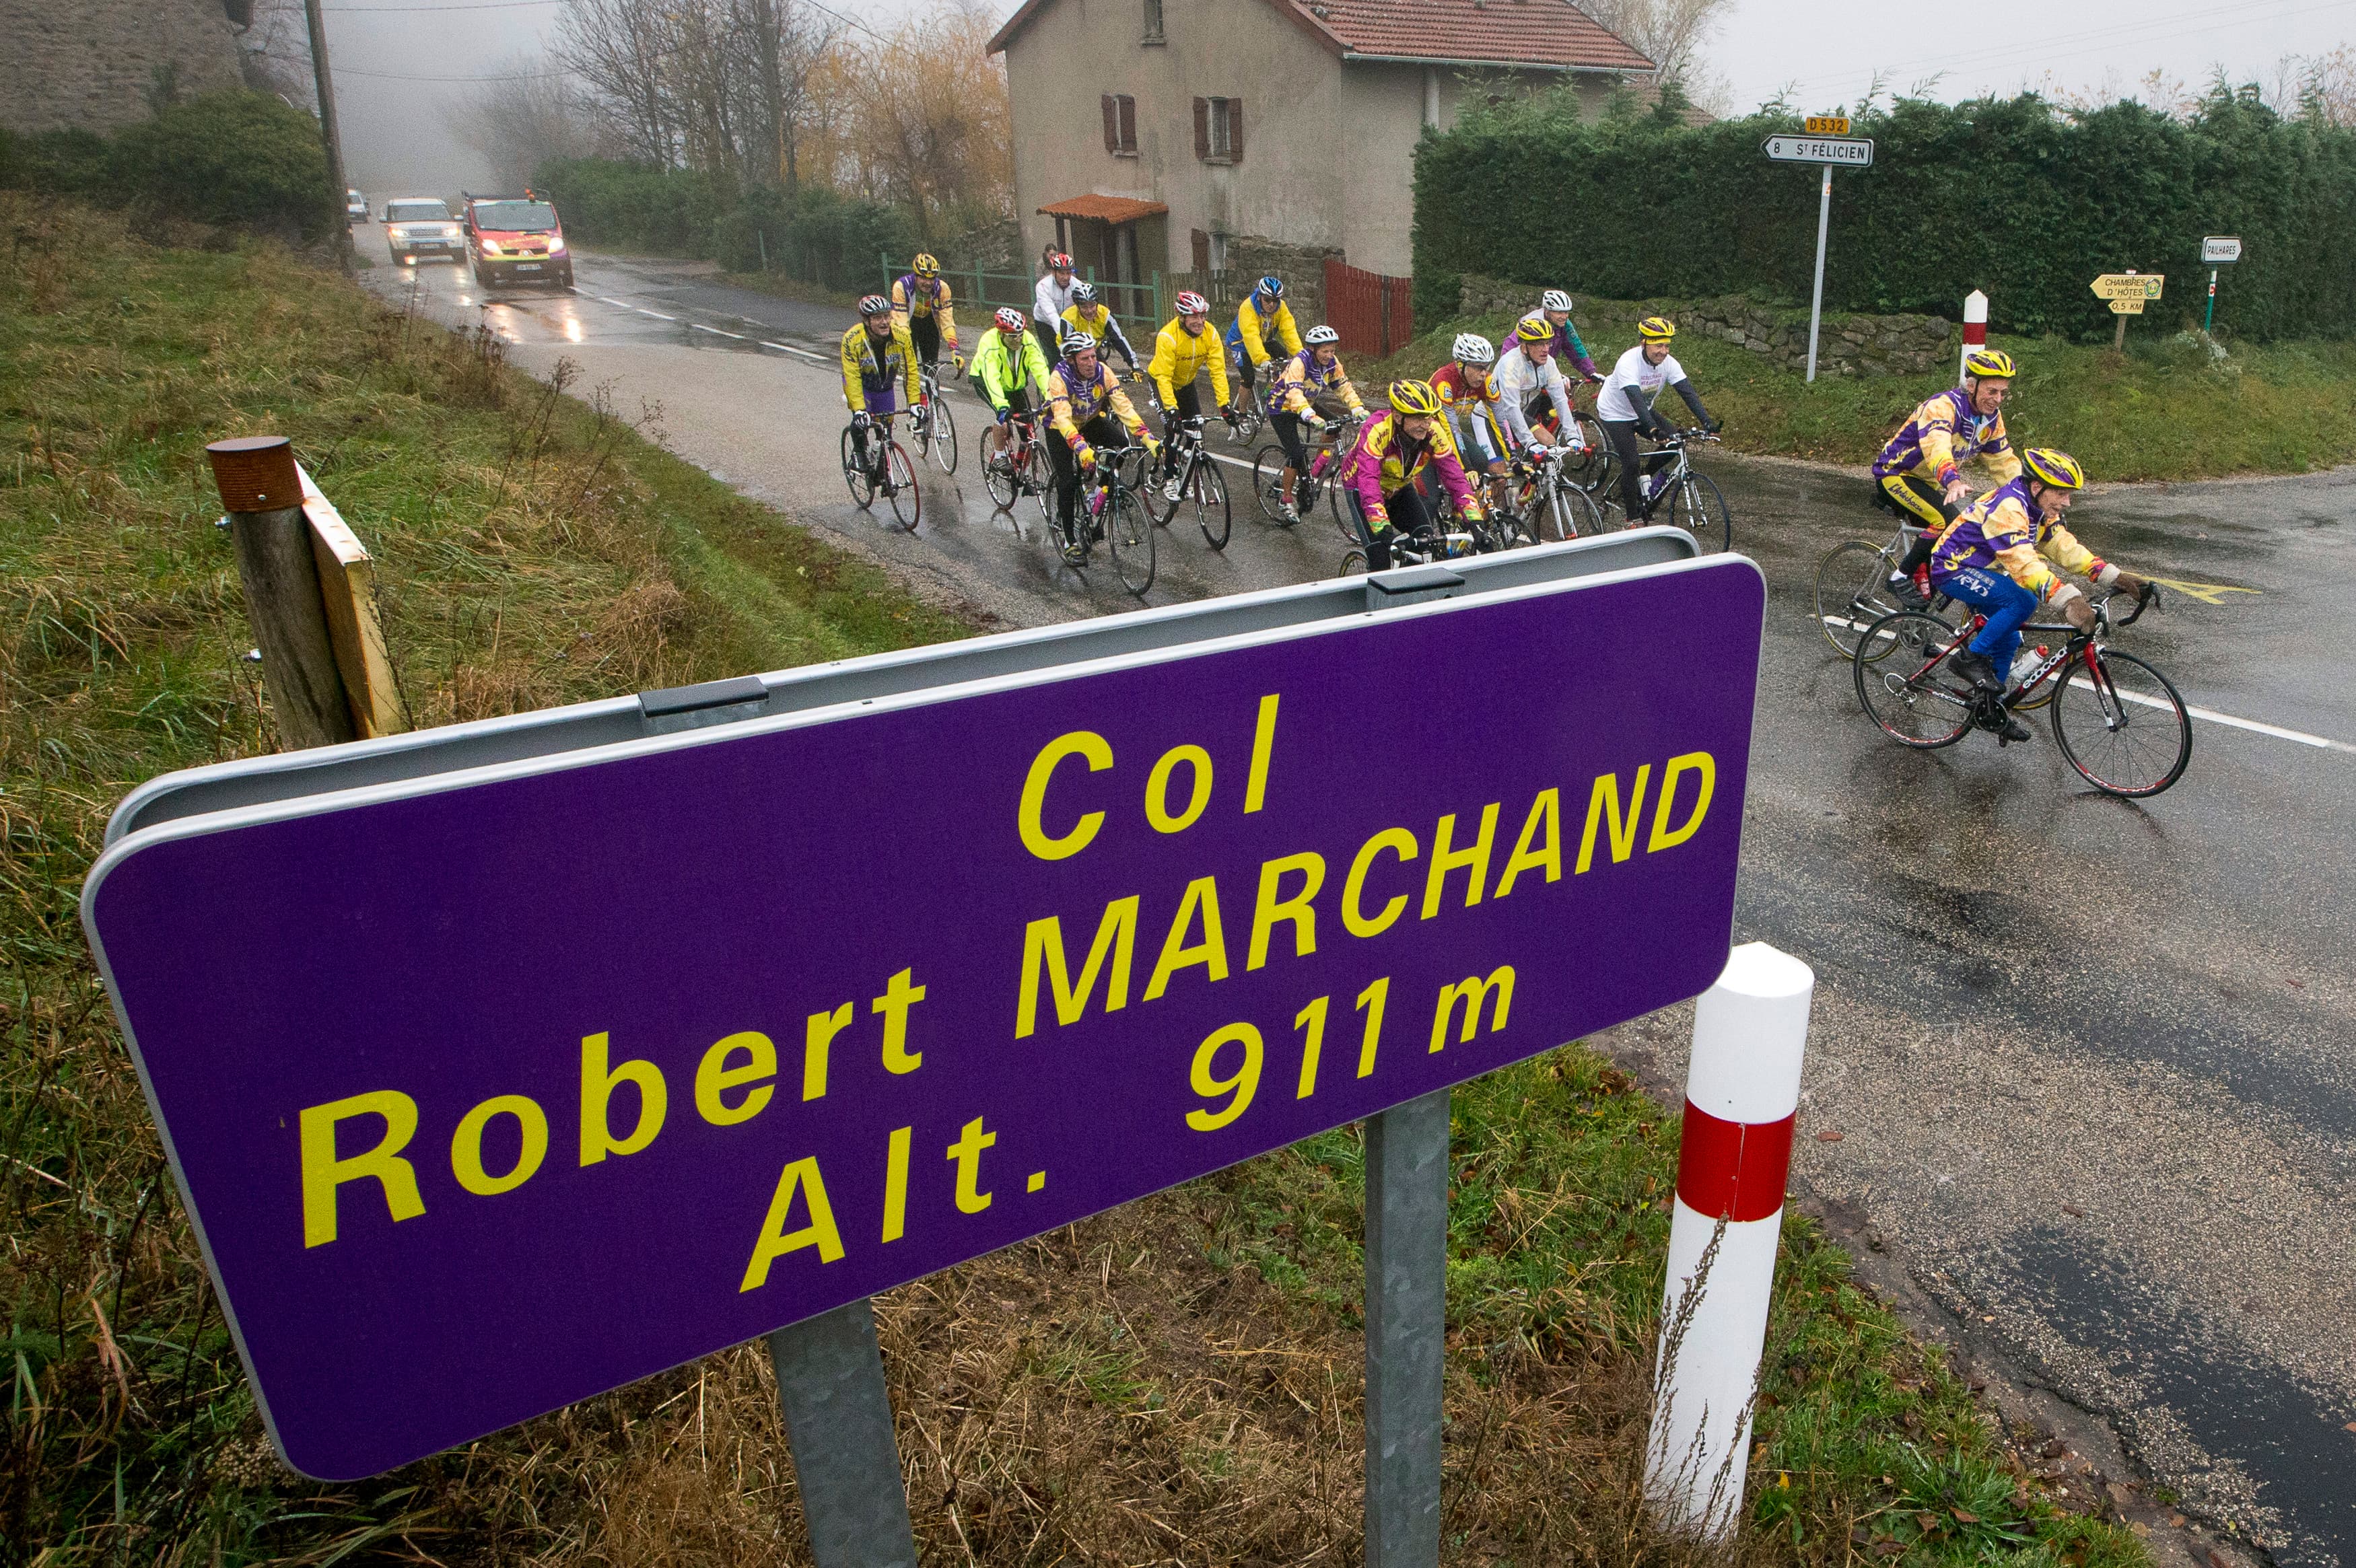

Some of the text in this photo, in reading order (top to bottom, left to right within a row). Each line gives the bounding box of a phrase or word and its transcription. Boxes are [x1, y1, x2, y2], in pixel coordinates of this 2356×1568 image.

[1809, 118, 1844, 131] D 532
[1774, 143, 1780, 153] 8
[1811, 143, 1865, 159] FÉLICIEN
[2207, 245, 2236, 255] PAILHARES
[2105, 279, 2145, 287] CHAMBRES
[2112, 302, 2126, 310] 0,5
[1018, 694, 1279, 860] Col
[300, 752, 1715, 1248] Robert MARCHAND
[740, 966, 1515, 1292] Alt. 911 m
